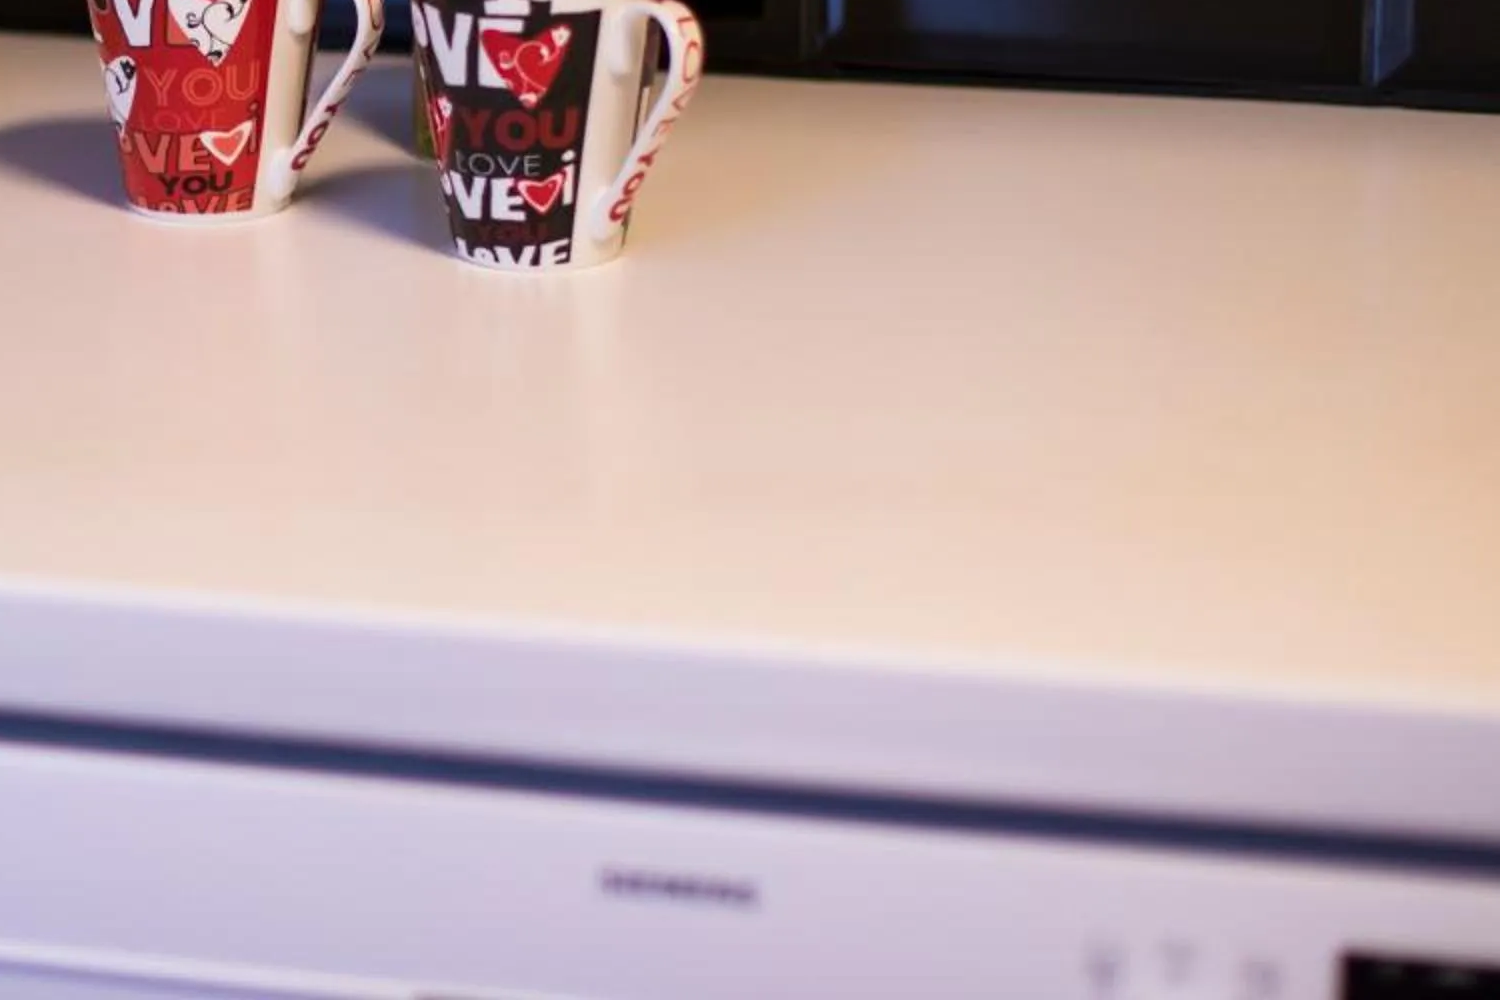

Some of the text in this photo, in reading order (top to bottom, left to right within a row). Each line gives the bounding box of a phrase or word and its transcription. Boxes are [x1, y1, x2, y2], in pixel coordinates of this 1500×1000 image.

[144, 63, 259, 107] YOU
[455, 104, 580, 150] YOU
[158, 170, 234, 197] YOU
